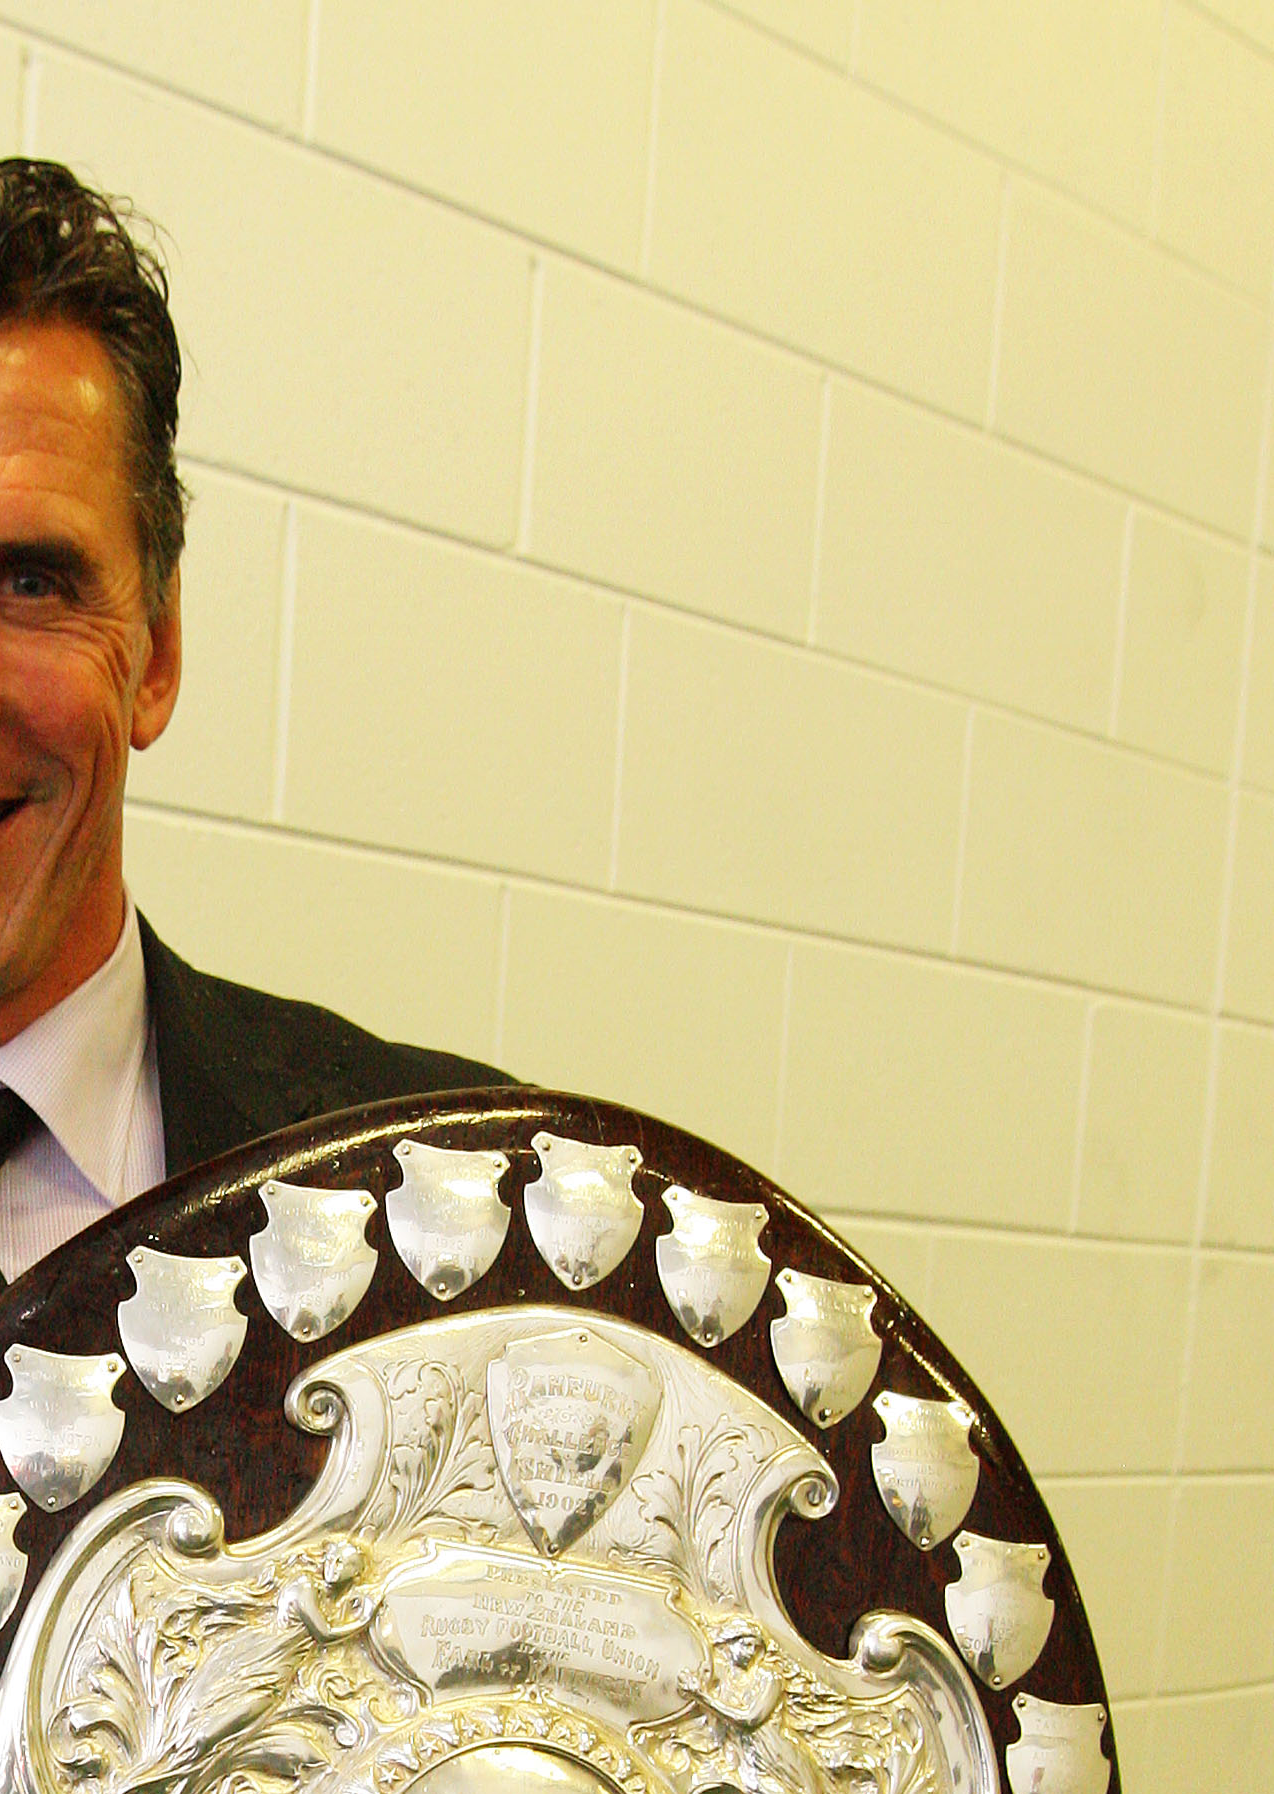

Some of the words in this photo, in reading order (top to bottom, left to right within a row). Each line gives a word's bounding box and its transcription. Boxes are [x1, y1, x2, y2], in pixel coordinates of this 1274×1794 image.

[472, 1594, 522, 1618] NEW
[526, 1604, 637, 1641] ZEALAND
[554, 1598, 586, 1614] THE
[420, 1613, 488, 1638] RUGBY
[494, 1619, 595, 1656] FOOTBALL
[602, 1639, 662, 1681] UNION
